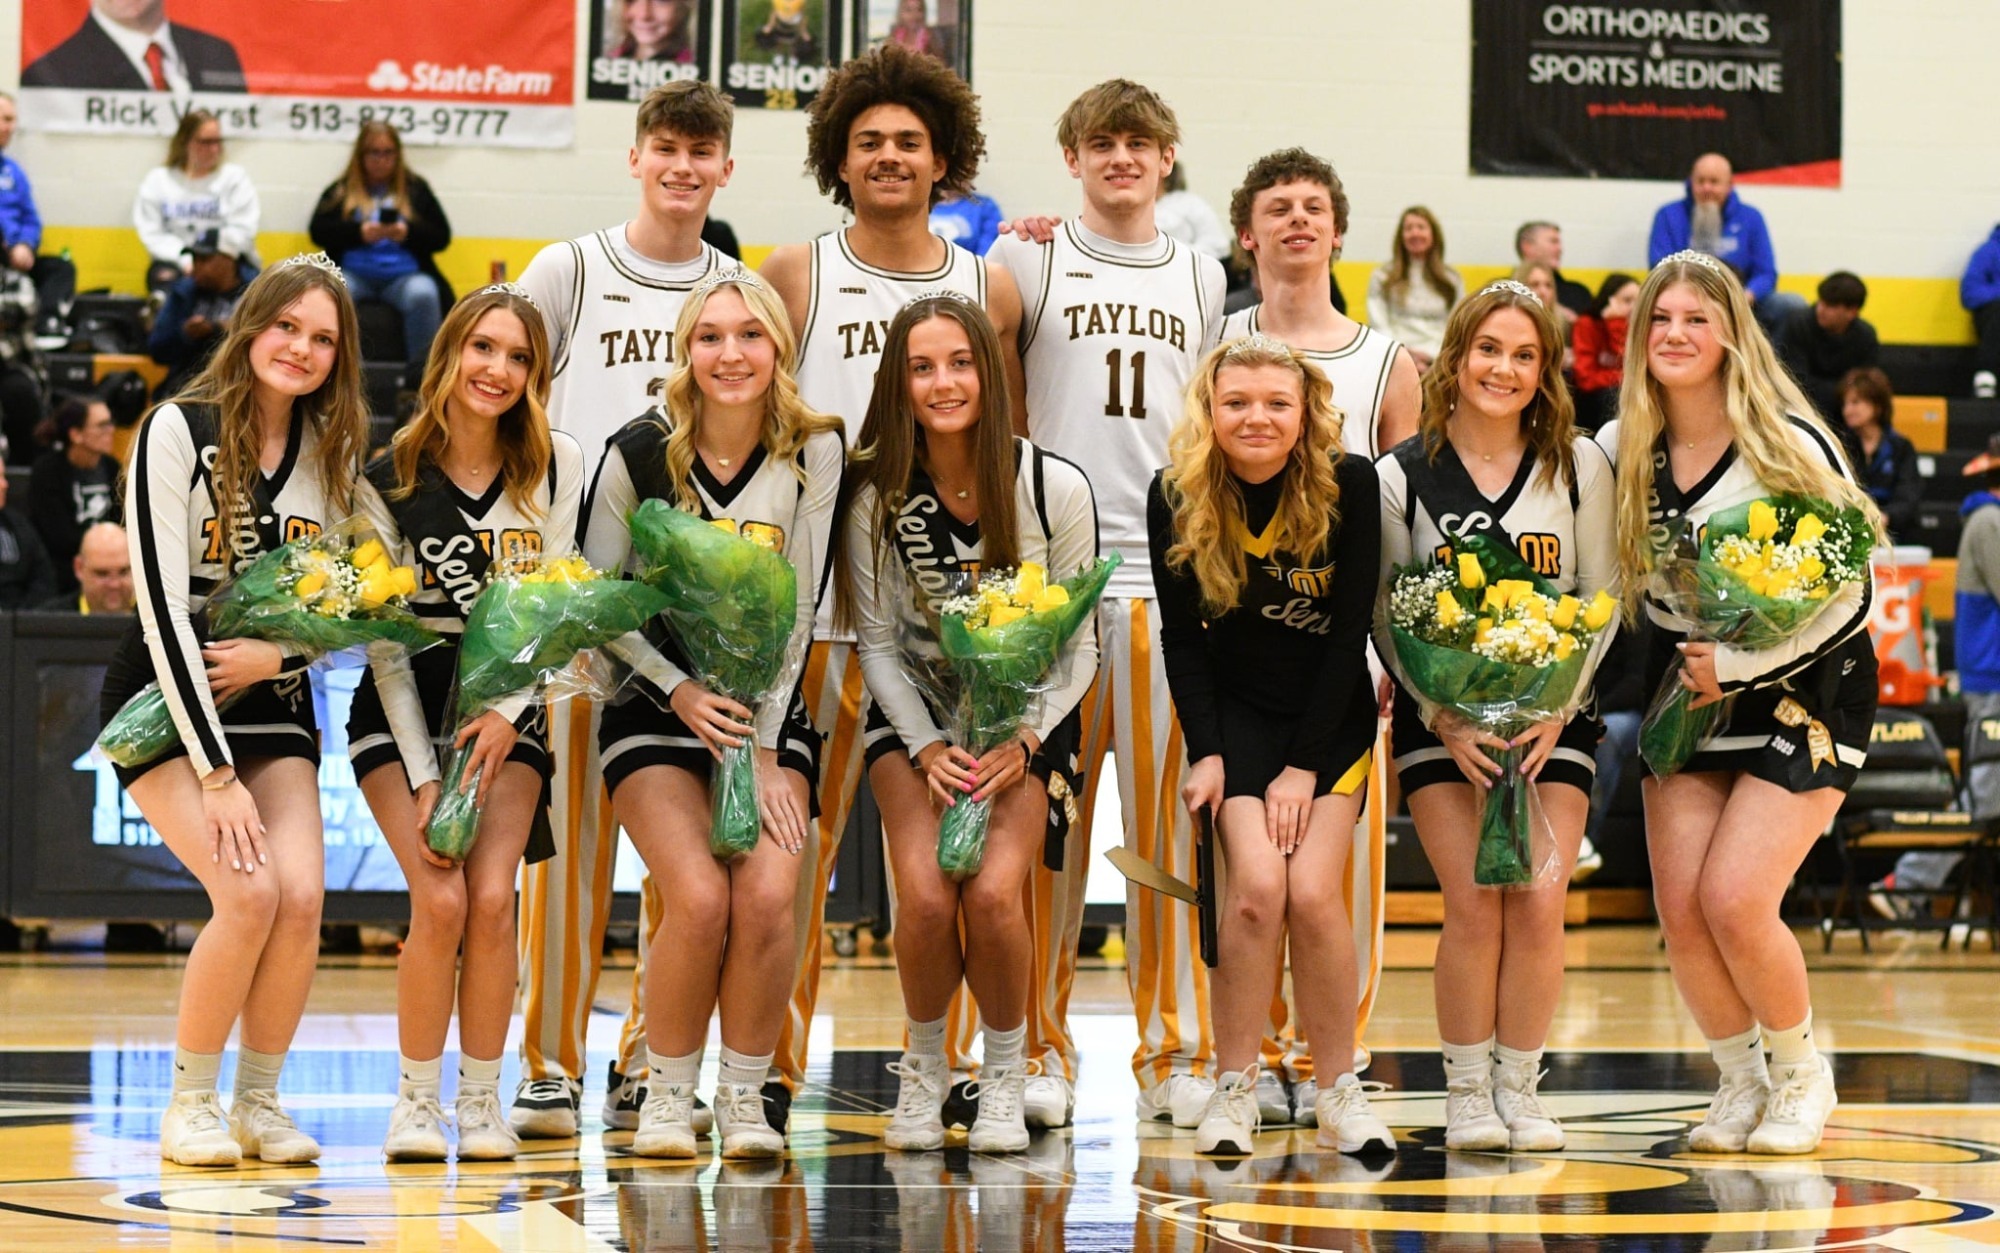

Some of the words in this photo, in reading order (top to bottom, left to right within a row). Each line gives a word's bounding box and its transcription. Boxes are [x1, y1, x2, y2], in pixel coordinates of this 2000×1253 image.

[1543, 5, 1770, 43] ORTHOPAEDICS
[1648, 41, 1665, 58] &
[1529, 54, 1639, 87] SPORTS
[1643, 59, 1783, 93] MEDICINE
[86, 97, 158, 125] Rick
[171, 99, 260, 128] Vrst
[290, 102, 509, 136] 513-873-9777
[765, 88, 797, 109] 25
[1064, 303, 1185, 353] TAYLOR
[1105, 348, 1147, 419] 11
[1873, 586, 1910, 633] G
